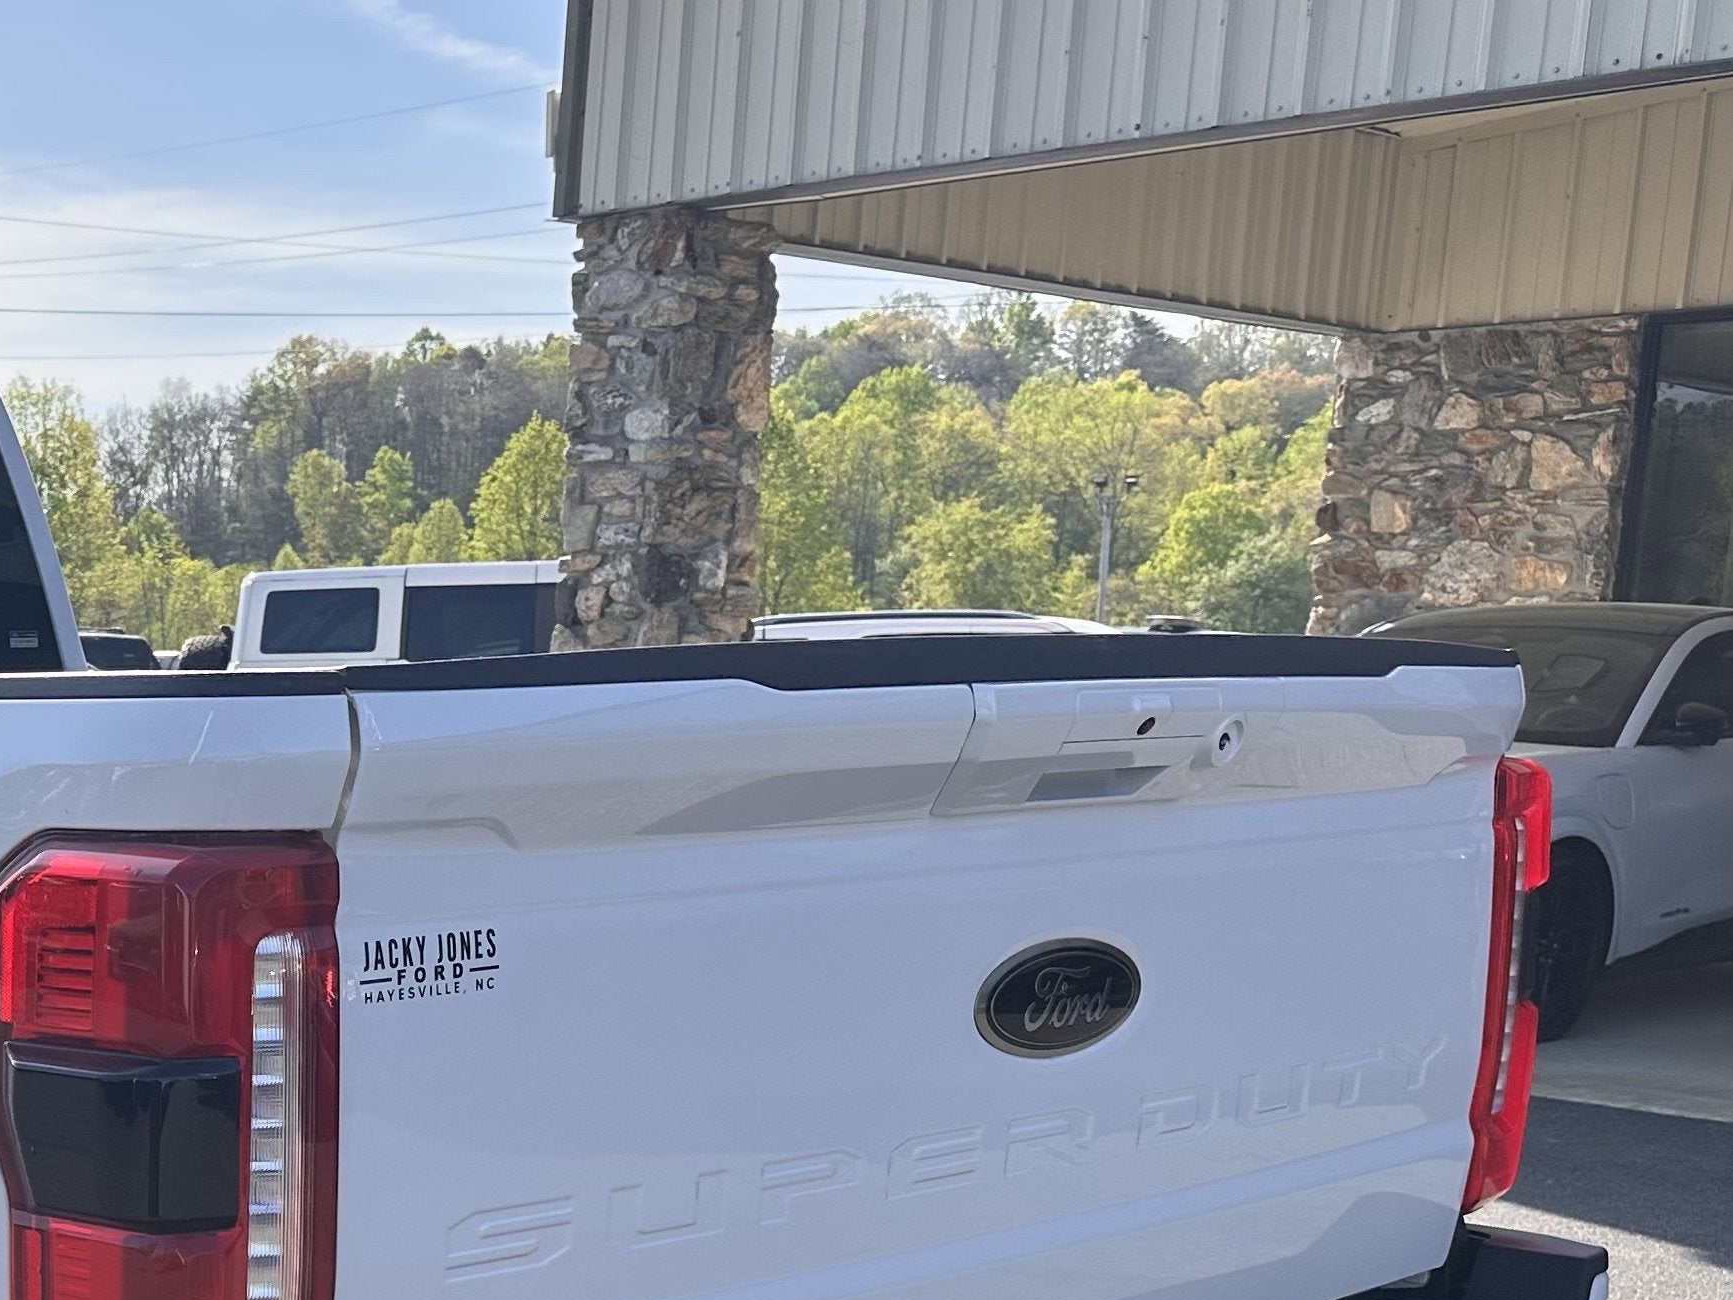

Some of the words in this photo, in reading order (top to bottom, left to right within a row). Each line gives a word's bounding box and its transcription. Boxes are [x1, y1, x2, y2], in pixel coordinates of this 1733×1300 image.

[363, 935, 426, 972] JACKY
[437, 928, 497, 964] JONES
[397, 962, 464, 986] FORD
[475, 977, 495, 991] NC
[1024, 965, 1112, 1032] Ford
[445, 1105, 1096, 1283] SUPER
[1135, 1033, 1448, 1149] DUTY
